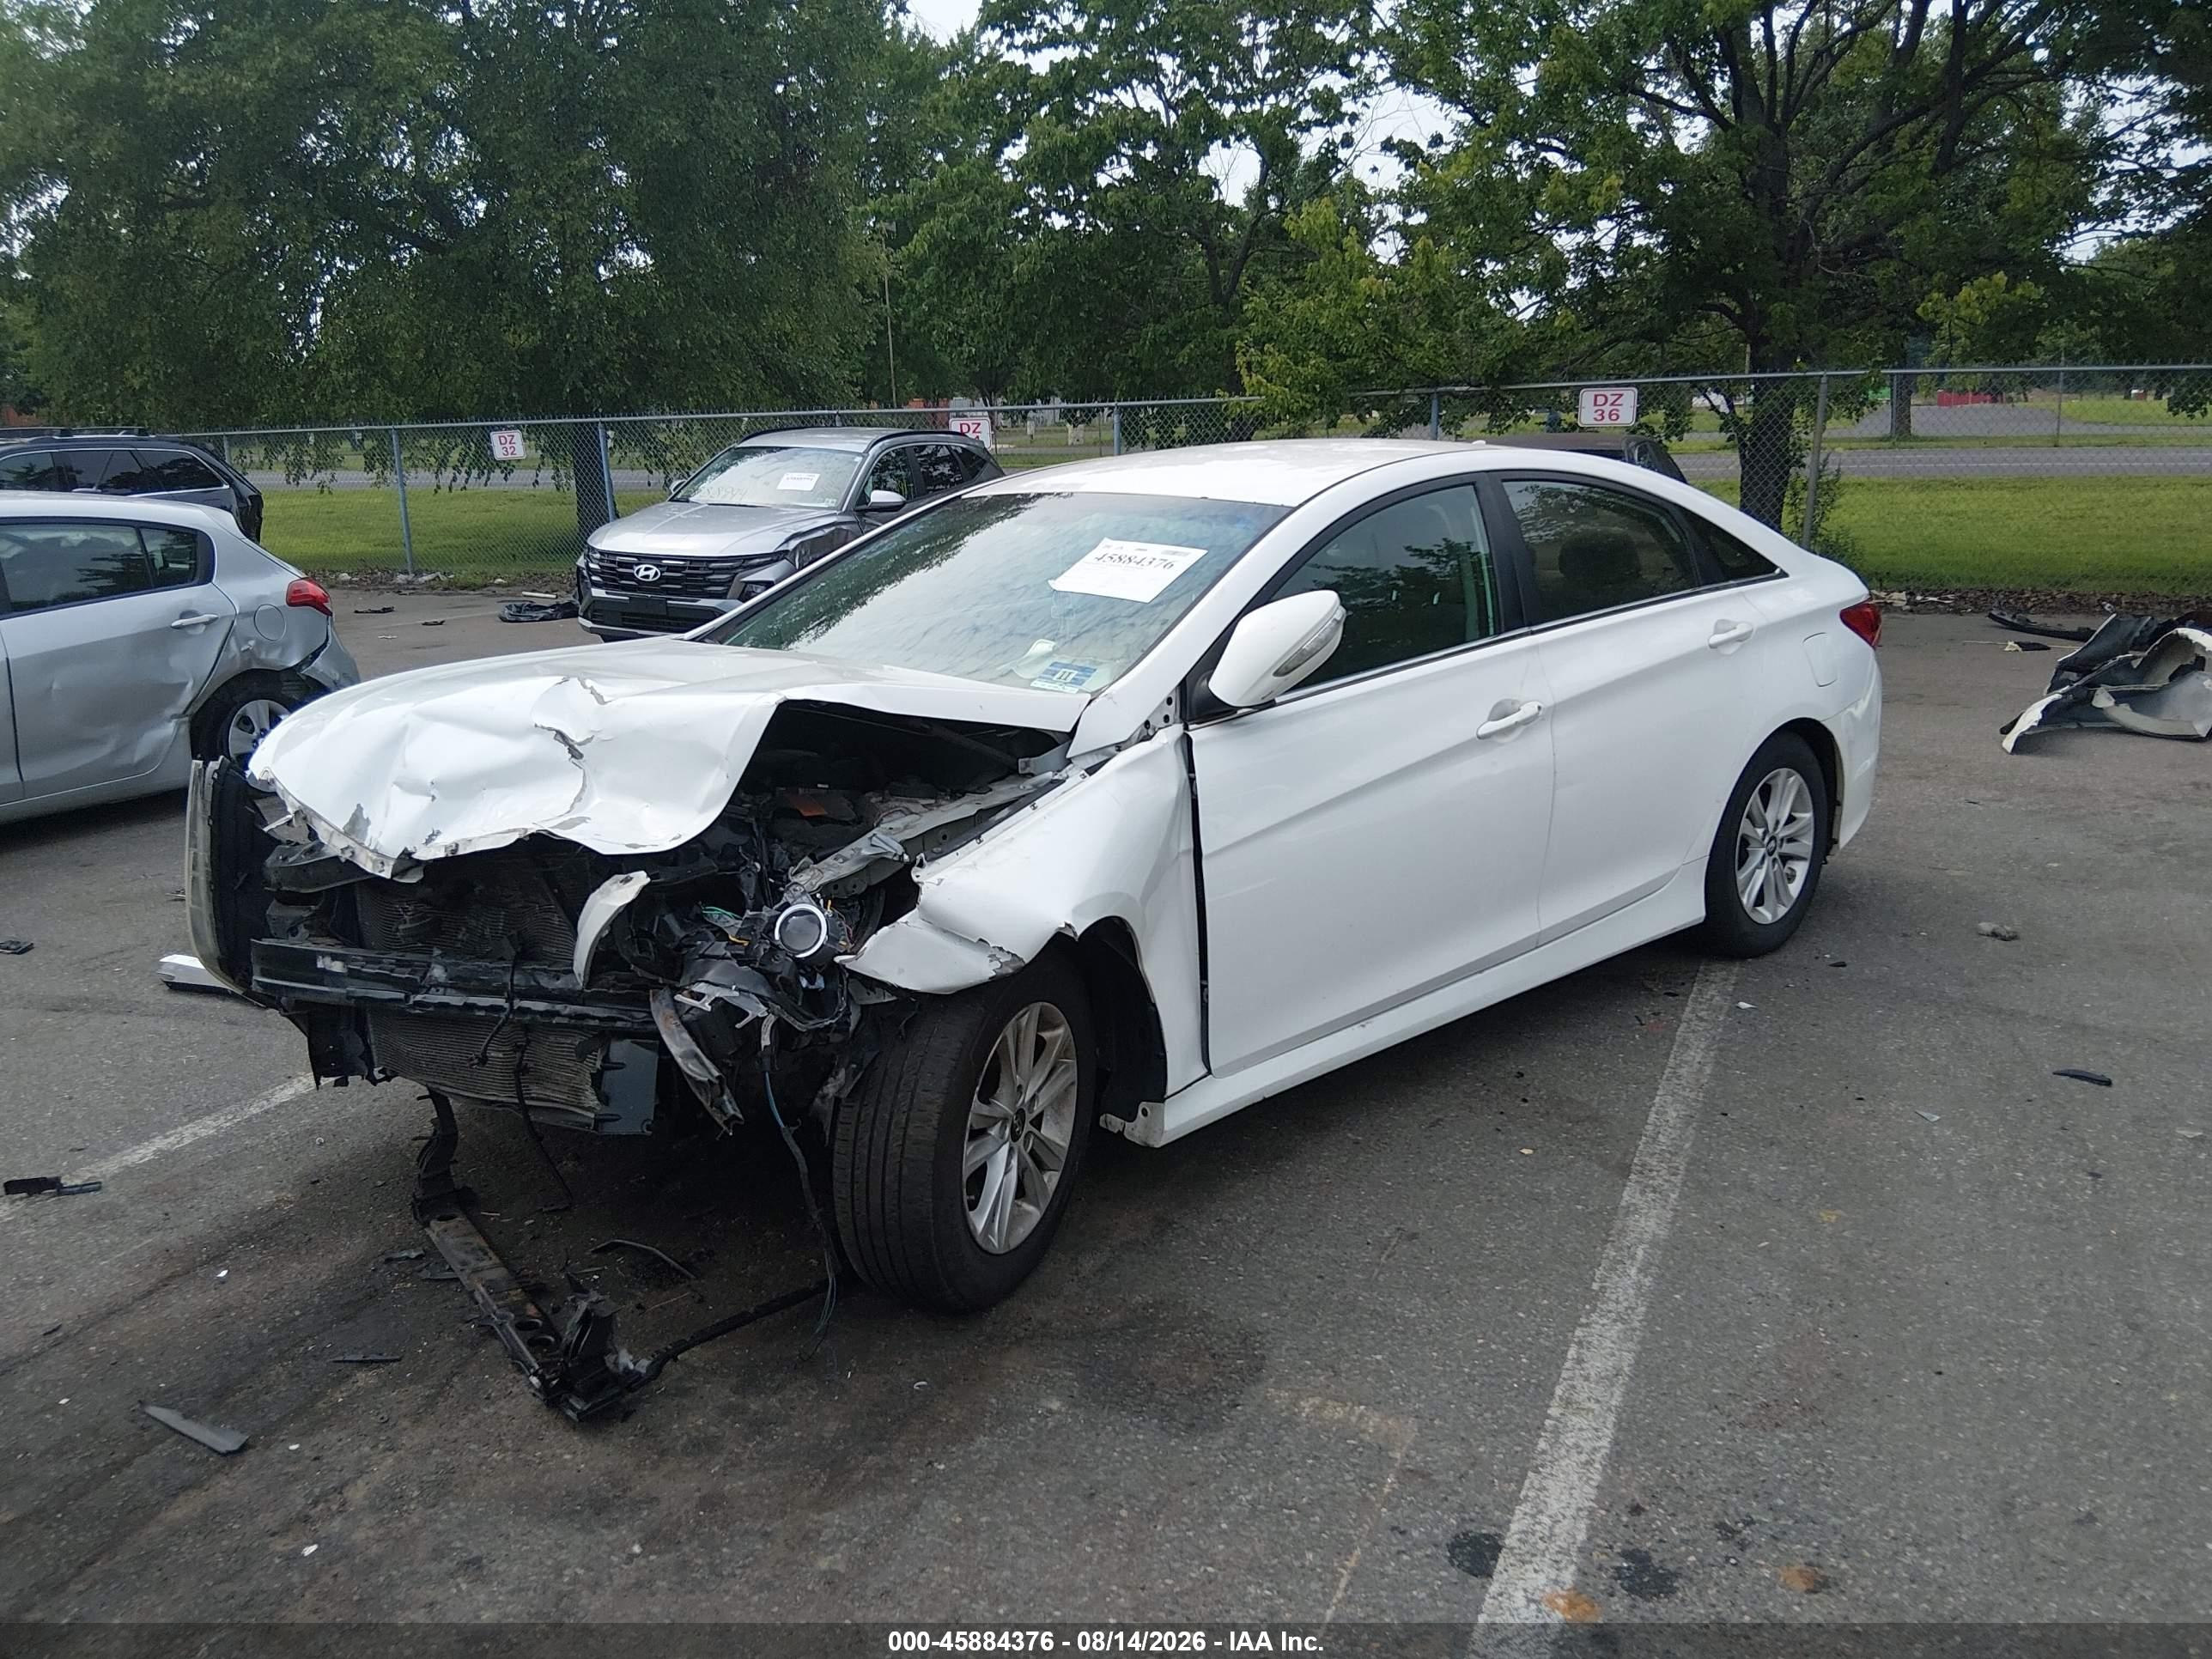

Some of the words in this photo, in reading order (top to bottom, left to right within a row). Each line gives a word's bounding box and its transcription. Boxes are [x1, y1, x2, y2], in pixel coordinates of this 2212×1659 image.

[1593, 393, 1624, 407] DZ
[1593, 408, 1620, 422] 36
[959, 422, 981, 434] DZ
[498, 434, 516, 446] DZ
[501, 446, 517, 456] 32
[1093, 552, 1178, 570] 45884376
